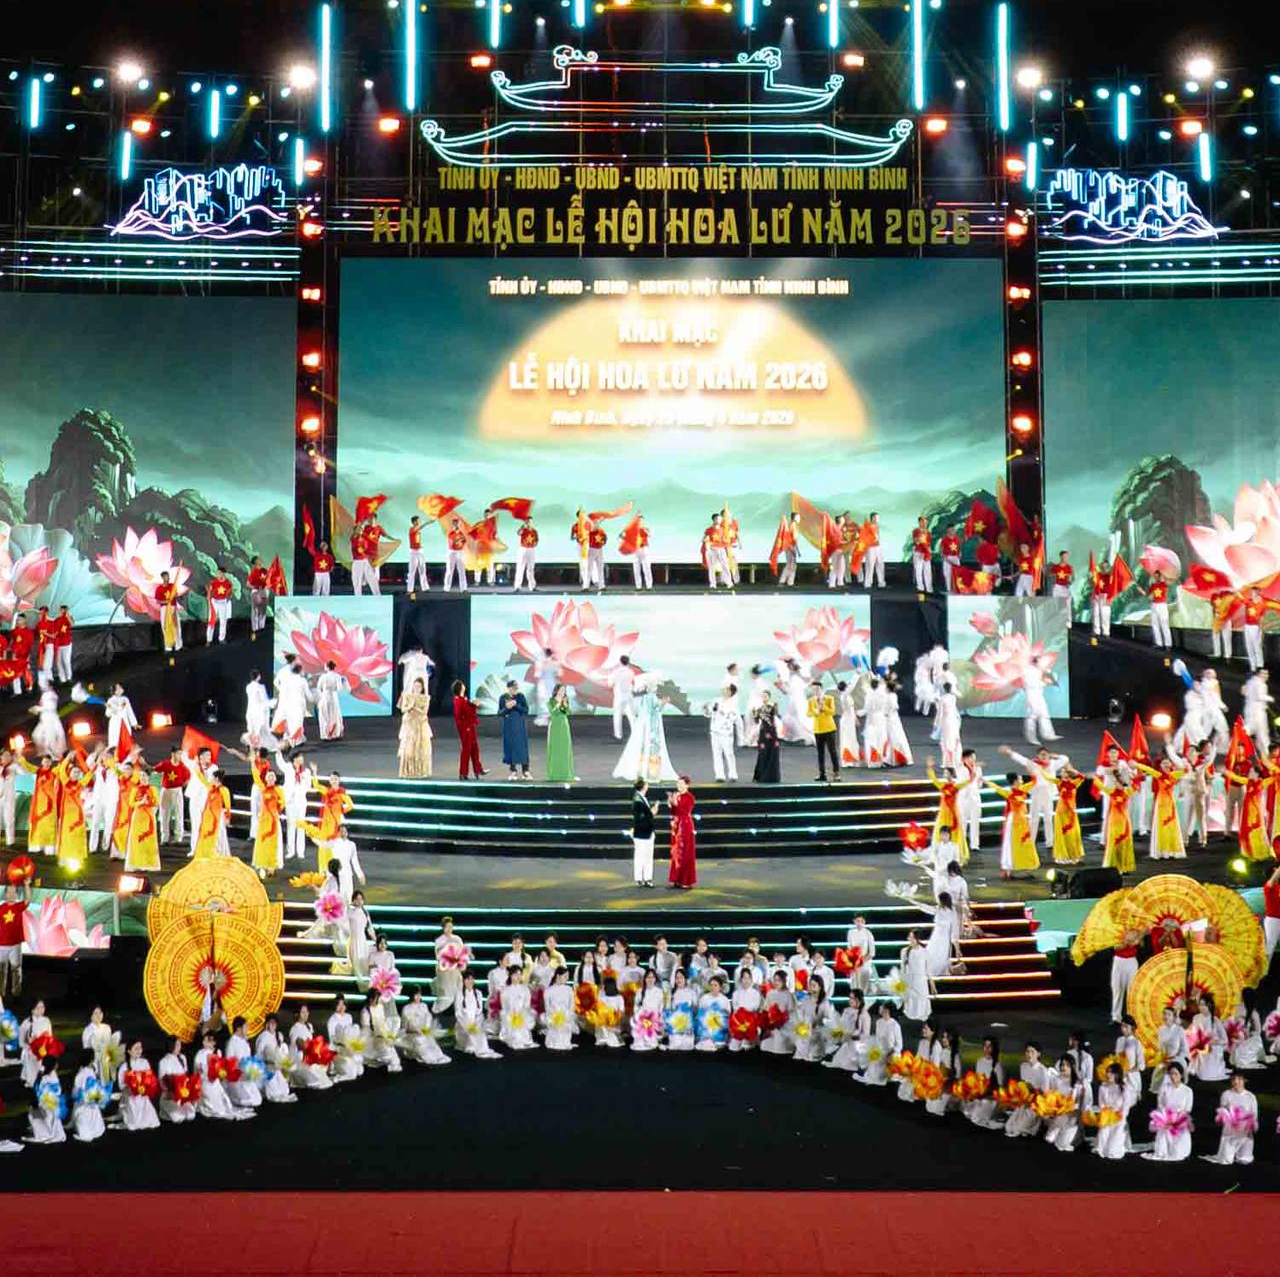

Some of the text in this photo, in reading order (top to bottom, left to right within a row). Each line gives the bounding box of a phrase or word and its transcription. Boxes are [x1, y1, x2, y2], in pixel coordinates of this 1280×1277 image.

[515, 166, 560, 190] HĐND
[575, 166, 620, 190] UBND
[635, 166, 699, 192] UBMTTQ
[703, 163, 737, 194] VIỆT
[741, 167, 778, 190] NAM
[783, 161, 820, 190] TỈNH
[824, 167, 866, 190] NINH
[870, 164, 908, 190] BÌNH
[372, 194, 970, 252] KHAI MẠC LỄ HỘI HOA LƯ NĂM 2026
[547, 355, 590, 396] HỘI
[598, 361, 650, 389] HOA
[765, 361, 828, 390] 2026
